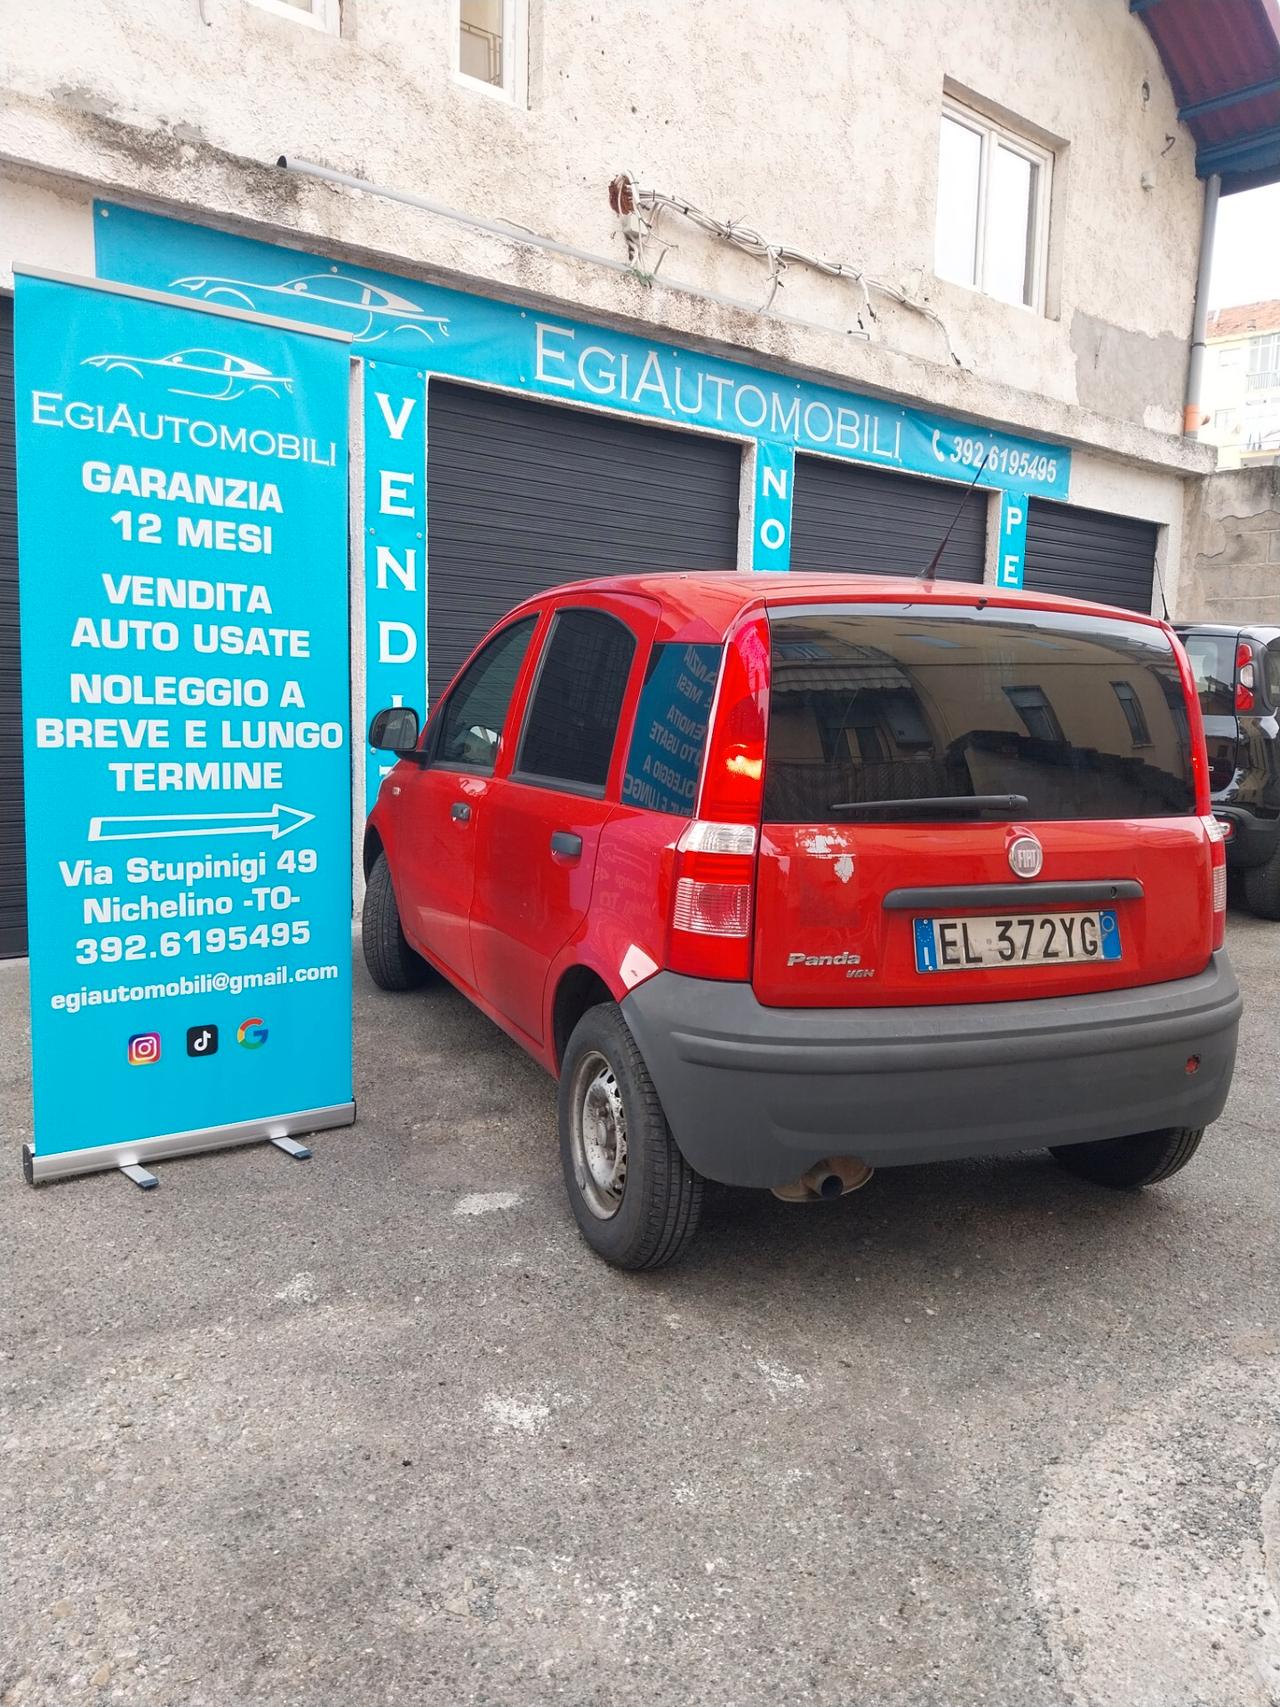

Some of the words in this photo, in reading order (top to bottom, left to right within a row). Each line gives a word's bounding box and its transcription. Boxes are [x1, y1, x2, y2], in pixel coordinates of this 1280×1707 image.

[82, 460, 284, 514] GARANZIA
[111, 510, 162, 544] 12
[177, 516, 272, 554] MESI
[102, 573, 273, 614] VENDITA
[71, 617, 179, 651] AUTO
[193, 623, 310, 658] USATE
[70, 673, 269, 707] NOLEGGIO
[280, 680, 305, 708] A
[36, 717, 170, 748] BREVE
[185, 719, 207, 748] E
[221, 720, 343, 749] LUNGO
[108, 762, 283, 792] TERMINE
[59, 860, 113, 887] Via
[126, 852, 266, 887] Stupinigi
[277, 849, 317, 874] 49
[1017, 849, 1037, 868] FIAT
[83, 892, 233, 924] Nichelino
[244, 886, 300, 912] -TO-
[76, 920, 310, 965] 392.6195495
[787, 952, 861, 966] Panda
[939, 922, 983, 965] EL
[995, 916, 1098, 961] 372YG
[51, 962, 339, 1013] egiautomobili@gmail.com
